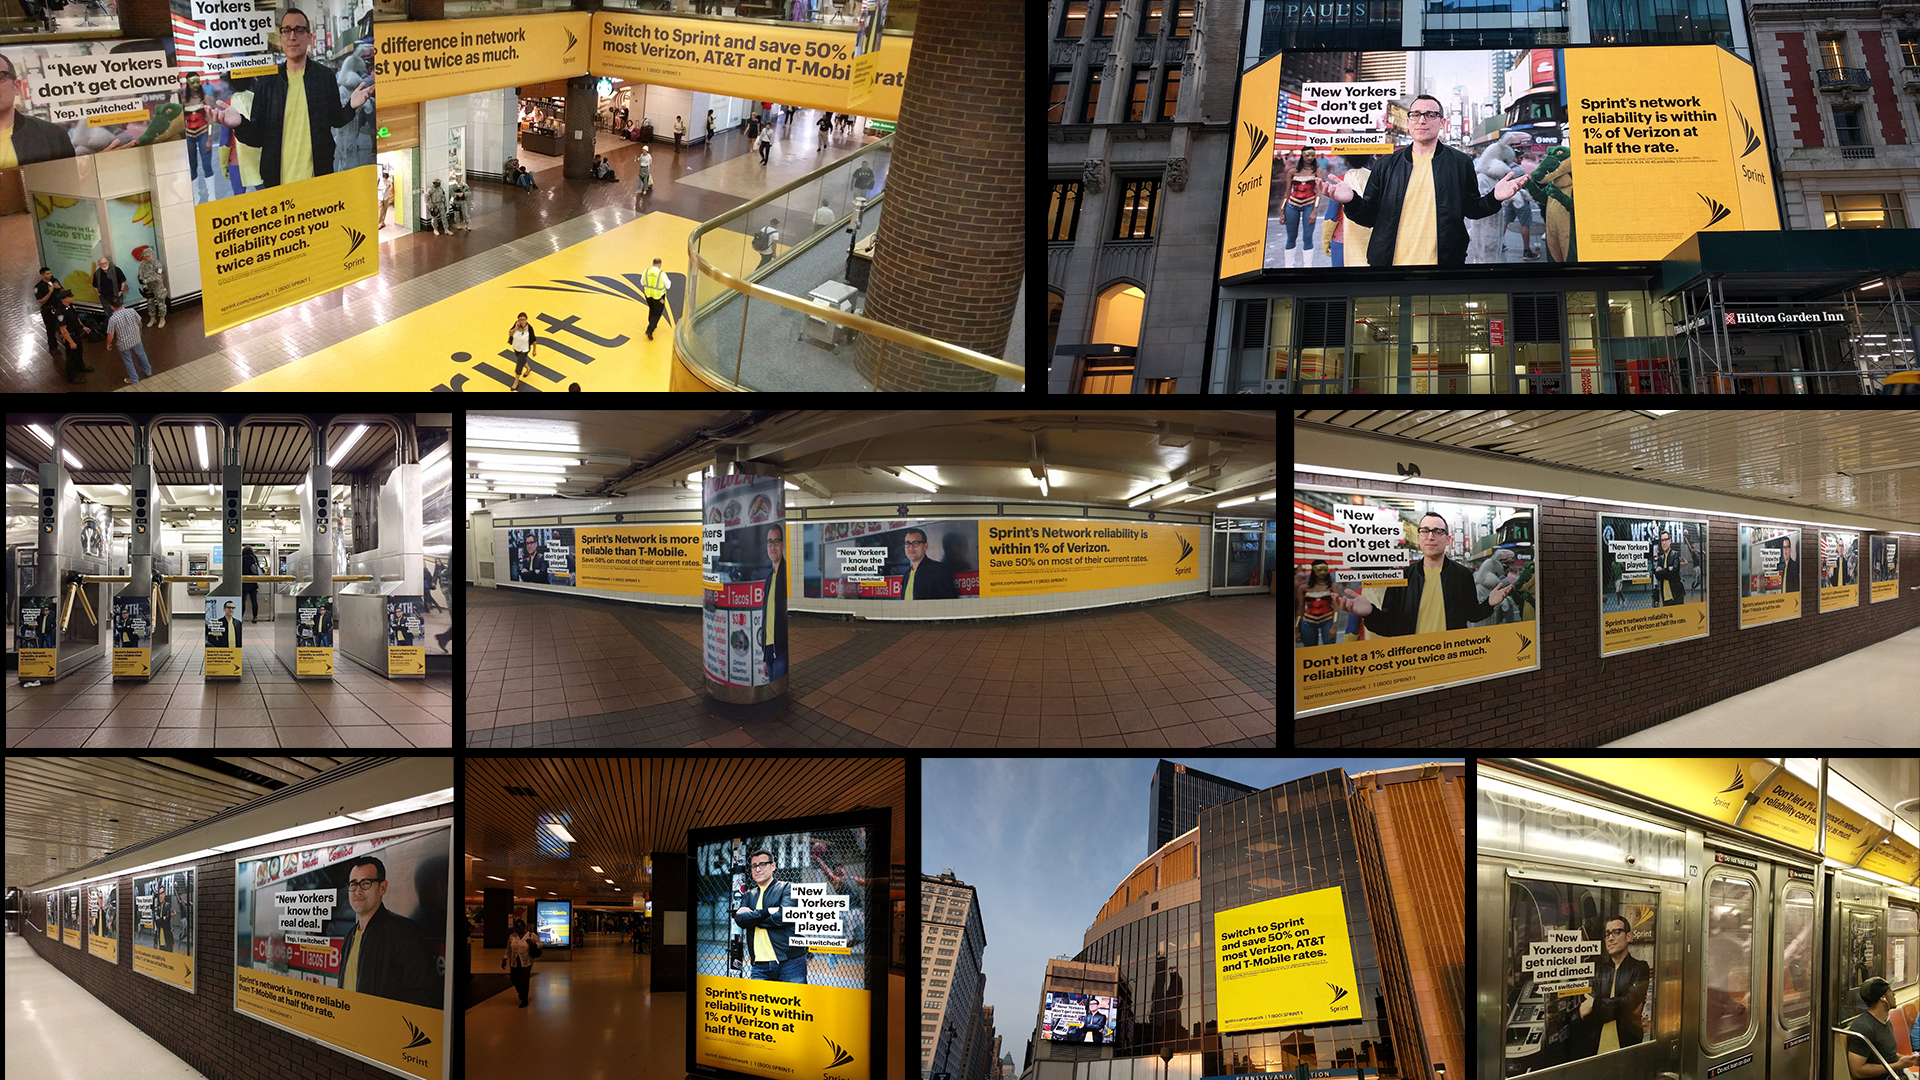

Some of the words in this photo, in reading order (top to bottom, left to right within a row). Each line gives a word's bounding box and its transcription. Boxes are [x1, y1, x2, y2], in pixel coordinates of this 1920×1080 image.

[195, 0, 251, 14] Yorkers
[210, 17, 247, 31] don’t
[249, 16, 272, 32] get
[199, 33, 264, 50] clowned.
[381, 36, 458, 54] difference
[461, 31, 473, 46] in
[475, 27, 526, 45] network
[603, 21, 651, 40] Switch
[654, 25, 669, 41] to
[672, 28, 720, 49] Sprint
[723, 35, 756, 51] and
[759, 40, 801, 56] save
[804, 41, 847, 61] 50%
[393, 58, 421, 76] you
[424, 52, 463, 70] twice
[466, 51, 480, 64] as
[482, 46, 519, 61] much.
[562, 56, 576, 65] Sprint
[602, 39, 638, 55] most
[640, 43, 700, 64] Verizon,
[703, 50, 746, 68] AT&T
[748, 57, 782, 73] and
[786, 59, 851, 81] T-Mobi
[47, 62, 97, 77] “New
[100, 58, 163, 74] Yorkers
[38, 81, 85, 97] don’t
[88, 79, 117, 96] get
[1304, 87, 1342, 98] “New
[1344, 86, 1397, 97] Yorkers
[1320, 100, 1356, 111] don’t
[1359, 100, 1383, 114] get
[1581, 97, 1637, 111] Sprint’s
[1640, 96, 1701, 108] network
[1308, 113, 1373, 126] clowned.
[1582, 112, 1652, 126] reliability
[1655, 111, 1668, 123] is
[1670, 110, 1717, 122] within
[1583, 127, 1602, 139] 1%
[1605, 126, 1621, 139] of
[1622, 126, 1680, 138] Verizon
[1682, 126, 1699, 137] at
[1309, 136, 1328, 145] Yep,
[1584, 141, 1613, 154] half
[1615, 141, 1641, 153] the
[1644, 142, 1679, 153] rate.
[1741, 164, 1766, 185] Sprint
[1237, 174, 1263, 197] Sprint
[212, 210, 248, 229] Don’t
[251, 205, 268, 220] let
[270, 206, 278, 215] a
[280, 199, 296, 212] 1%
[213, 218, 282, 244] difference
[284, 214, 295, 225] in
[297, 201, 345, 221] network
[215, 233, 277, 260] reliability
[280, 226, 305, 241] cost
[307, 221, 329, 235] you
[216, 255, 255, 275] twice
[256, 251, 271, 263] as
[273, 239, 310, 258] much.
[343, 256, 365, 271] Sprint
[1737, 313, 1776, 324] Hilton
[1778, 312, 1821, 322] Garden
[1822, 311, 1845, 322] Inn
[430, 312, 631, 384] rint
[1336, 509, 1374, 521] “New
[989, 527, 1039, 541] Sprint’s
[1042, 527, 1091, 538] Network
[1093, 529, 1139, 540] reliability
[1141, 529, 1148, 538] is
[1349, 524, 1400, 536] Yorkers
[581, 534, 614, 545] Sprint’s
[615, 534, 657, 545] Network
[659, 534, 667, 543] is
[1328, 537, 1365, 549] don’t
[1368, 539, 1390, 550] get
[581, 546, 613, 556] reliable
[615, 546, 636, 556] than
[639, 546, 687, 557] T-Mobile.
[990, 543, 1031, 555] within
[1034, 542, 1050, 554] 1%
[1052, 542, 1065, 553] of
[1066, 543, 1110, 553] Verizon.
[1347, 552, 1407, 563] clowned.
[1175, 567, 1191, 576] Sprint
[1303, 652, 1339, 669] Don’t
[1342, 650, 1359, 663] let
[1361, 653, 1368, 661] a
[1370, 649, 1385, 659] 1%
[1387, 642, 1442, 658] difference
[1444, 640, 1452, 650] in
[1454, 635, 1491, 649] network
[1516, 654, 1531, 662] Sprint
[1303, 664, 1366, 682] reliability
[1368, 659, 1393, 672] cost
[1395, 657, 1416, 670] you
[1417, 653, 1445, 666] twice
[1447, 652, 1459, 660] as
[1460, 645, 1487, 658] much.
[1303, 685, 1366, 700] sprint.com/network
[1712, 796, 1731, 810] Sprint
[1689, 866, 1698, 876] 10
[792, 886, 823, 896] “New
[801, 898, 845, 908] Yorkers
[785, 909, 814, 920] don’t
[815, 911, 836, 921] get
[798, 922, 841, 934] played.
[1221, 927, 1256, 941] Switch
[1257, 924, 1268, 933] to
[1270, 917, 1305, 931] Sprint
[1633, 930, 1652, 939] Sprint
[1222, 939, 1240, 951] and
[1242, 936, 1266, 947] save
[1268, 930, 1293, 942] 50%
[1295, 928, 1310, 937] on
[1550, 934, 1578, 943] “New
[1222, 950, 1247, 961] most
[1250, 942, 1294, 956] Verizon,
[1296, 936, 1326, 949] AT&T
[1533, 945, 1573, 956] Yorkers
[1575, 943, 1598, 954] don’t
[1222, 961, 1241, 973] and
[1243, 954, 1291, 969] T-Mobile
[1293, 949, 1327, 961] rates.
[1525, 958, 1544, 969] get
[1546, 956, 1577, 966] nickel
[1536, 968, 1557, 979] and
[1559, 966, 1593, 977] dimed.
[705, 987, 747, 1001] Sprint’s
[750, 993, 801, 1007] network
[705, 999, 758, 1016] reliability
[760, 1006, 771, 1016] is
[773, 1008, 814, 1022] within
[1330, 1005, 1349, 1013] Sprint
[704, 1011, 719, 1022] 1%
[721, 1013, 733, 1024] of
[734, 1015, 780, 1031] Verizon
[781, 1022, 795, 1033] at
[704, 1023, 726, 1036] half
[727, 1026, 747, 1038] the
[749, 1031, 776, 1043] rate.
[402, 1052, 428, 1068] Sprint
